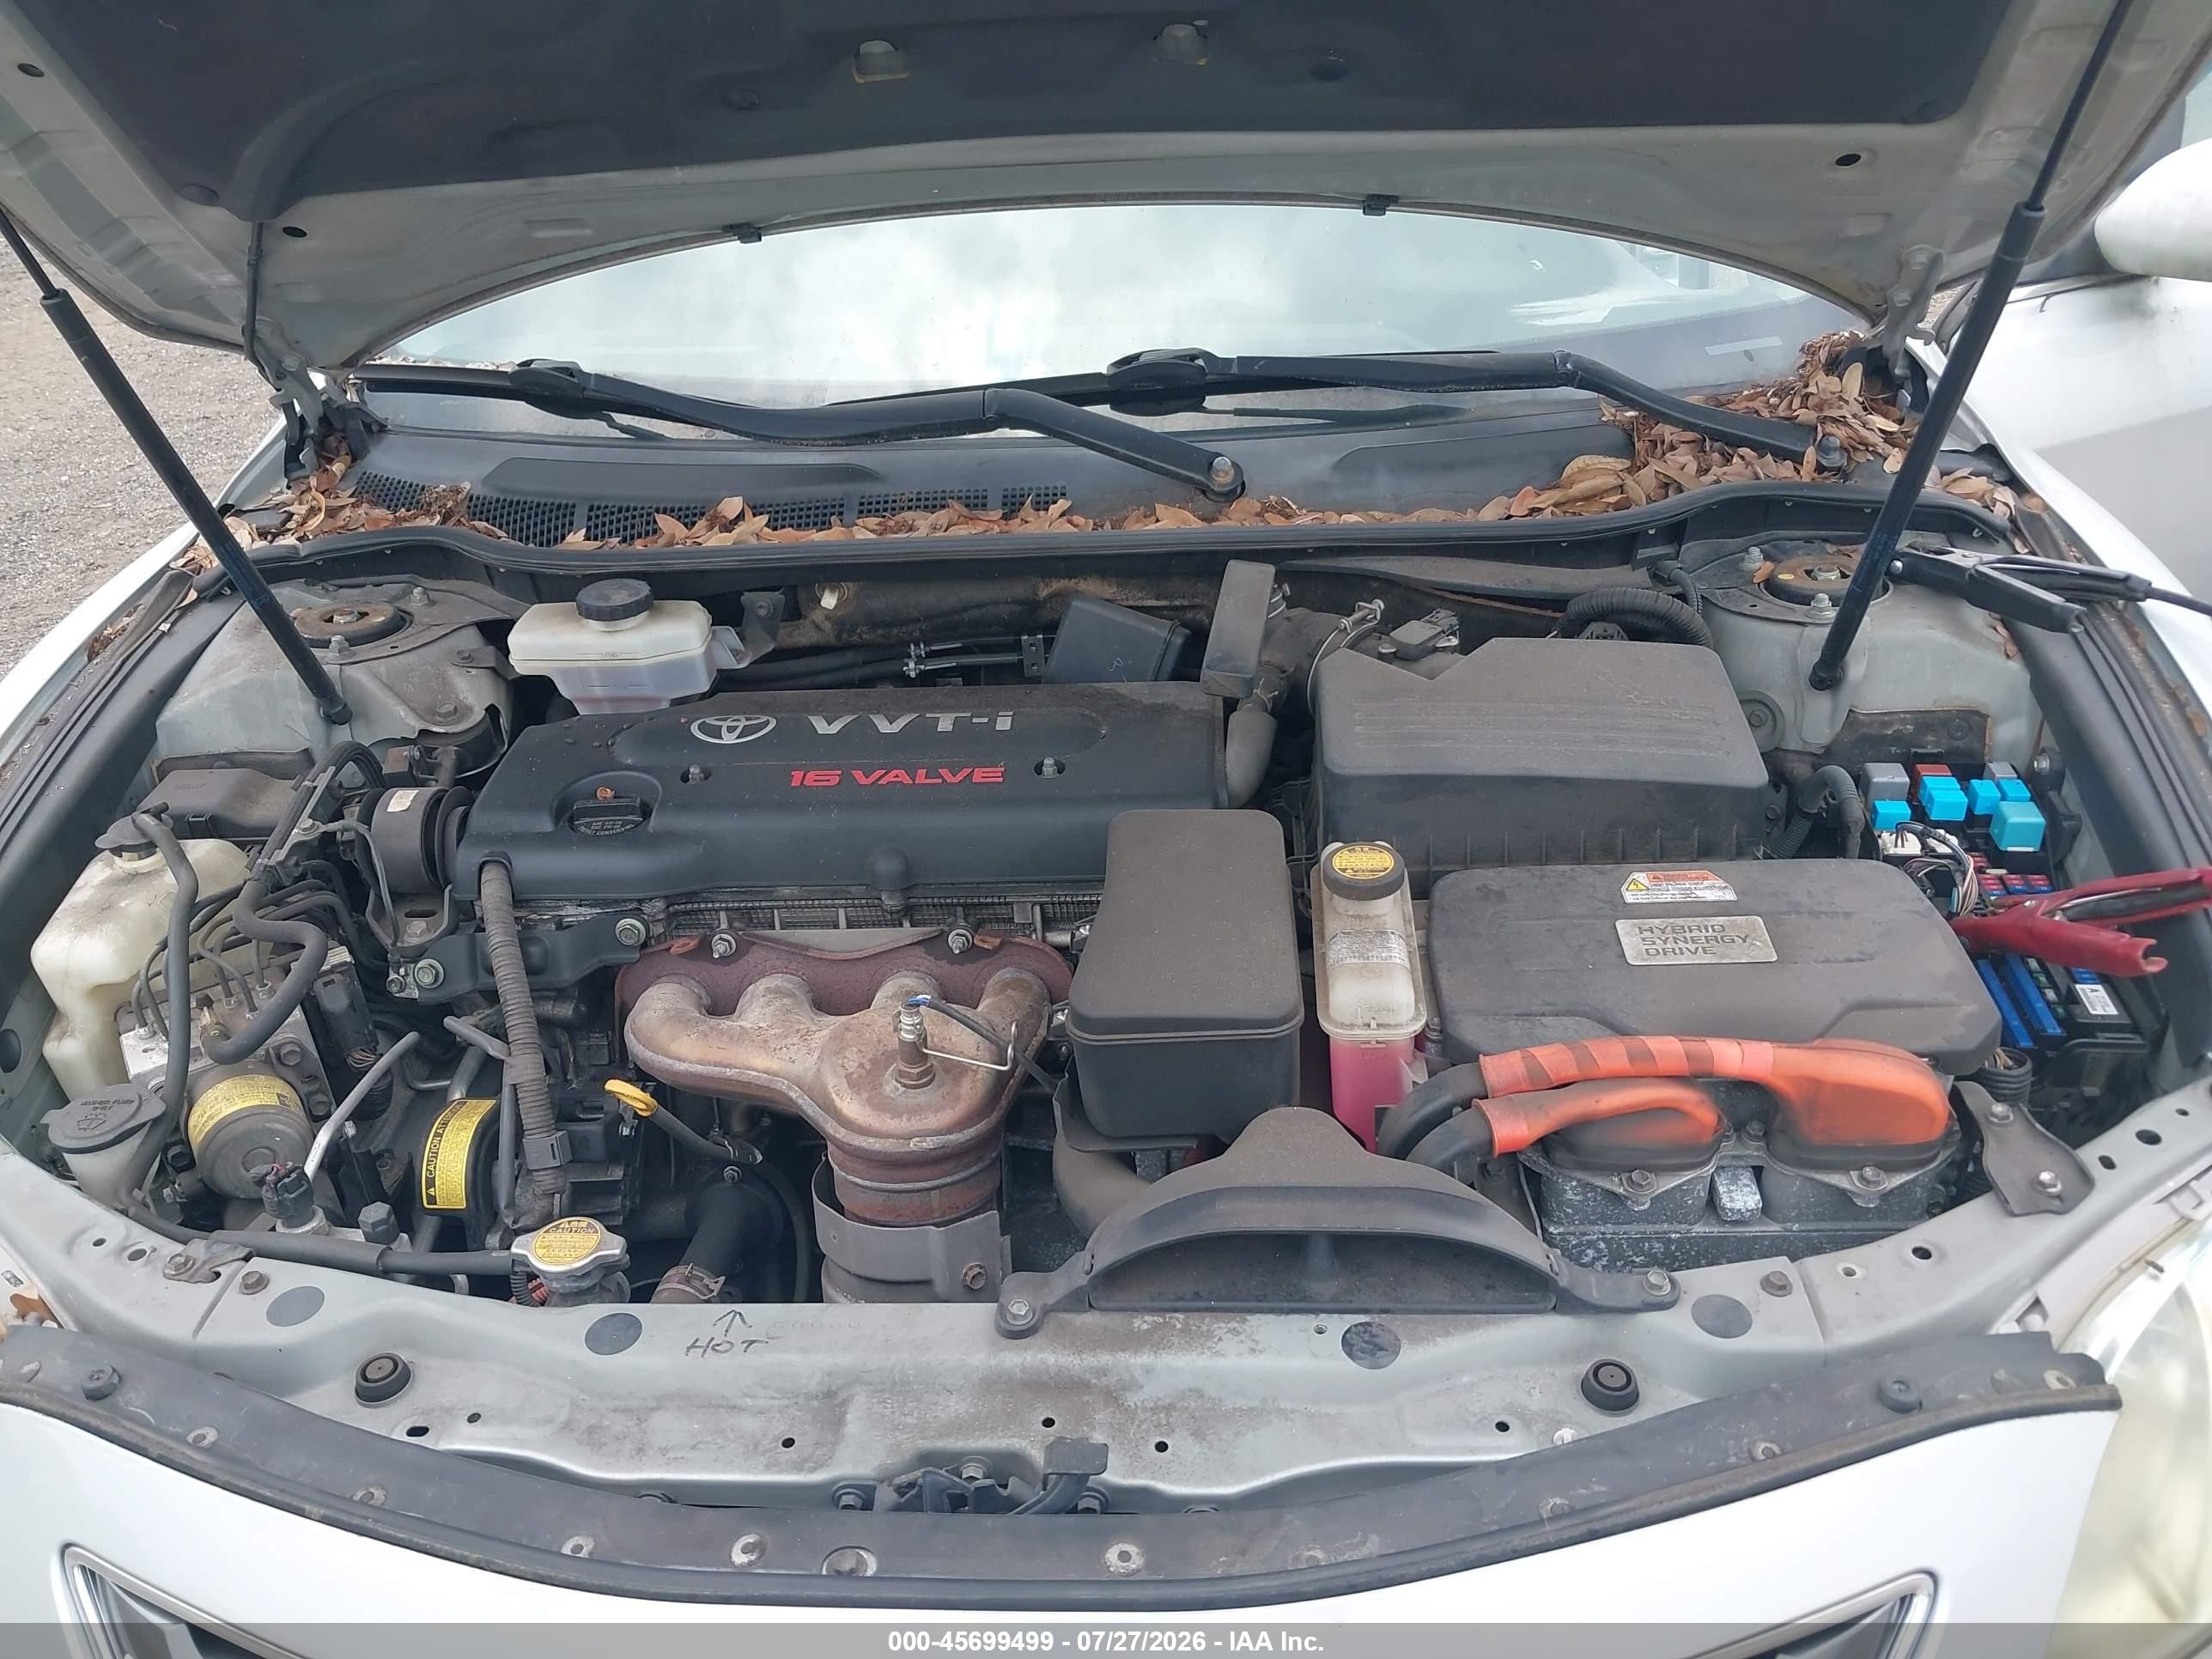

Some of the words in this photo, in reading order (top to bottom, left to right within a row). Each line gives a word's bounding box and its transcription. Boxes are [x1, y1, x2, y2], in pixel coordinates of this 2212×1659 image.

[807, 711, 1014, 734] VVT-i
[790, 769, 842, 787] 16
[851, 767, 1006, 785] VALVE
[1637, 924, 1726, 935] HYBRID
[1641, 934, 1749, 945] SYNERGY
[1644, 946, 1717, 957] DRIVE
[427, 1136, 441, 1178] CAUTION
[684, 1337, 769, 1358] HOT
